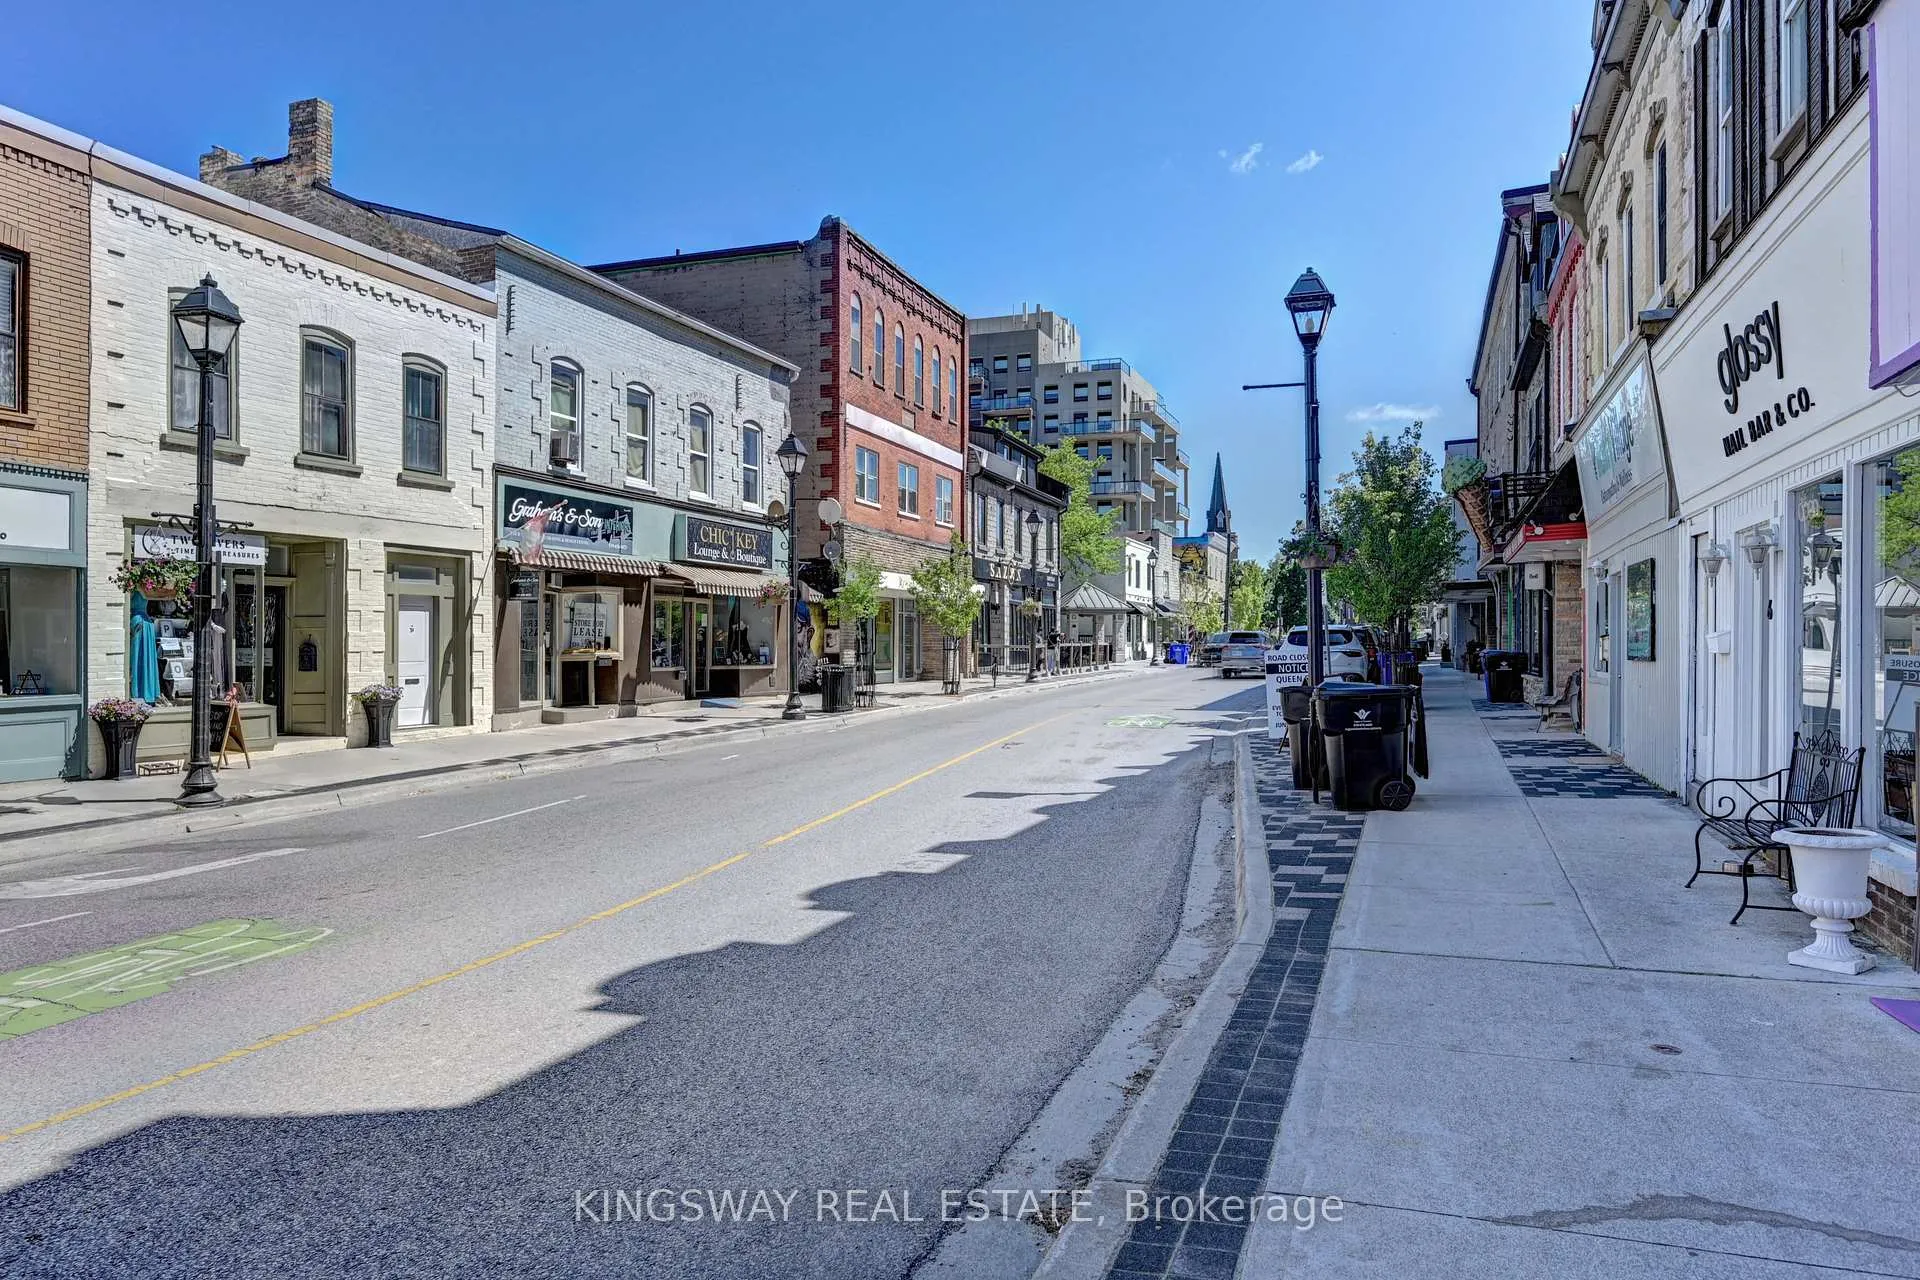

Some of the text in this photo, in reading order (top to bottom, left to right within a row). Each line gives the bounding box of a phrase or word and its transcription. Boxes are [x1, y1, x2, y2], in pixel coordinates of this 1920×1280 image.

[1718, 301, 1784, 414] glossy
[1723, 387, 1815, 457] NAIL BAR & CO.
[565, 508, 578, 523] &
[578, 509, 602, 528] Son
[171, 534, 191, 545] TW
[700, 526, 758, 549] CHIC KEY
[223, 551, 260, 559] REASURES
[694, 543, 766, 565] Lounge & Boutique
[573, 627, 603, 637] LEASE
[186, 645, 192, 653] R
[1276, 675, 1302, 684] QUEEN
